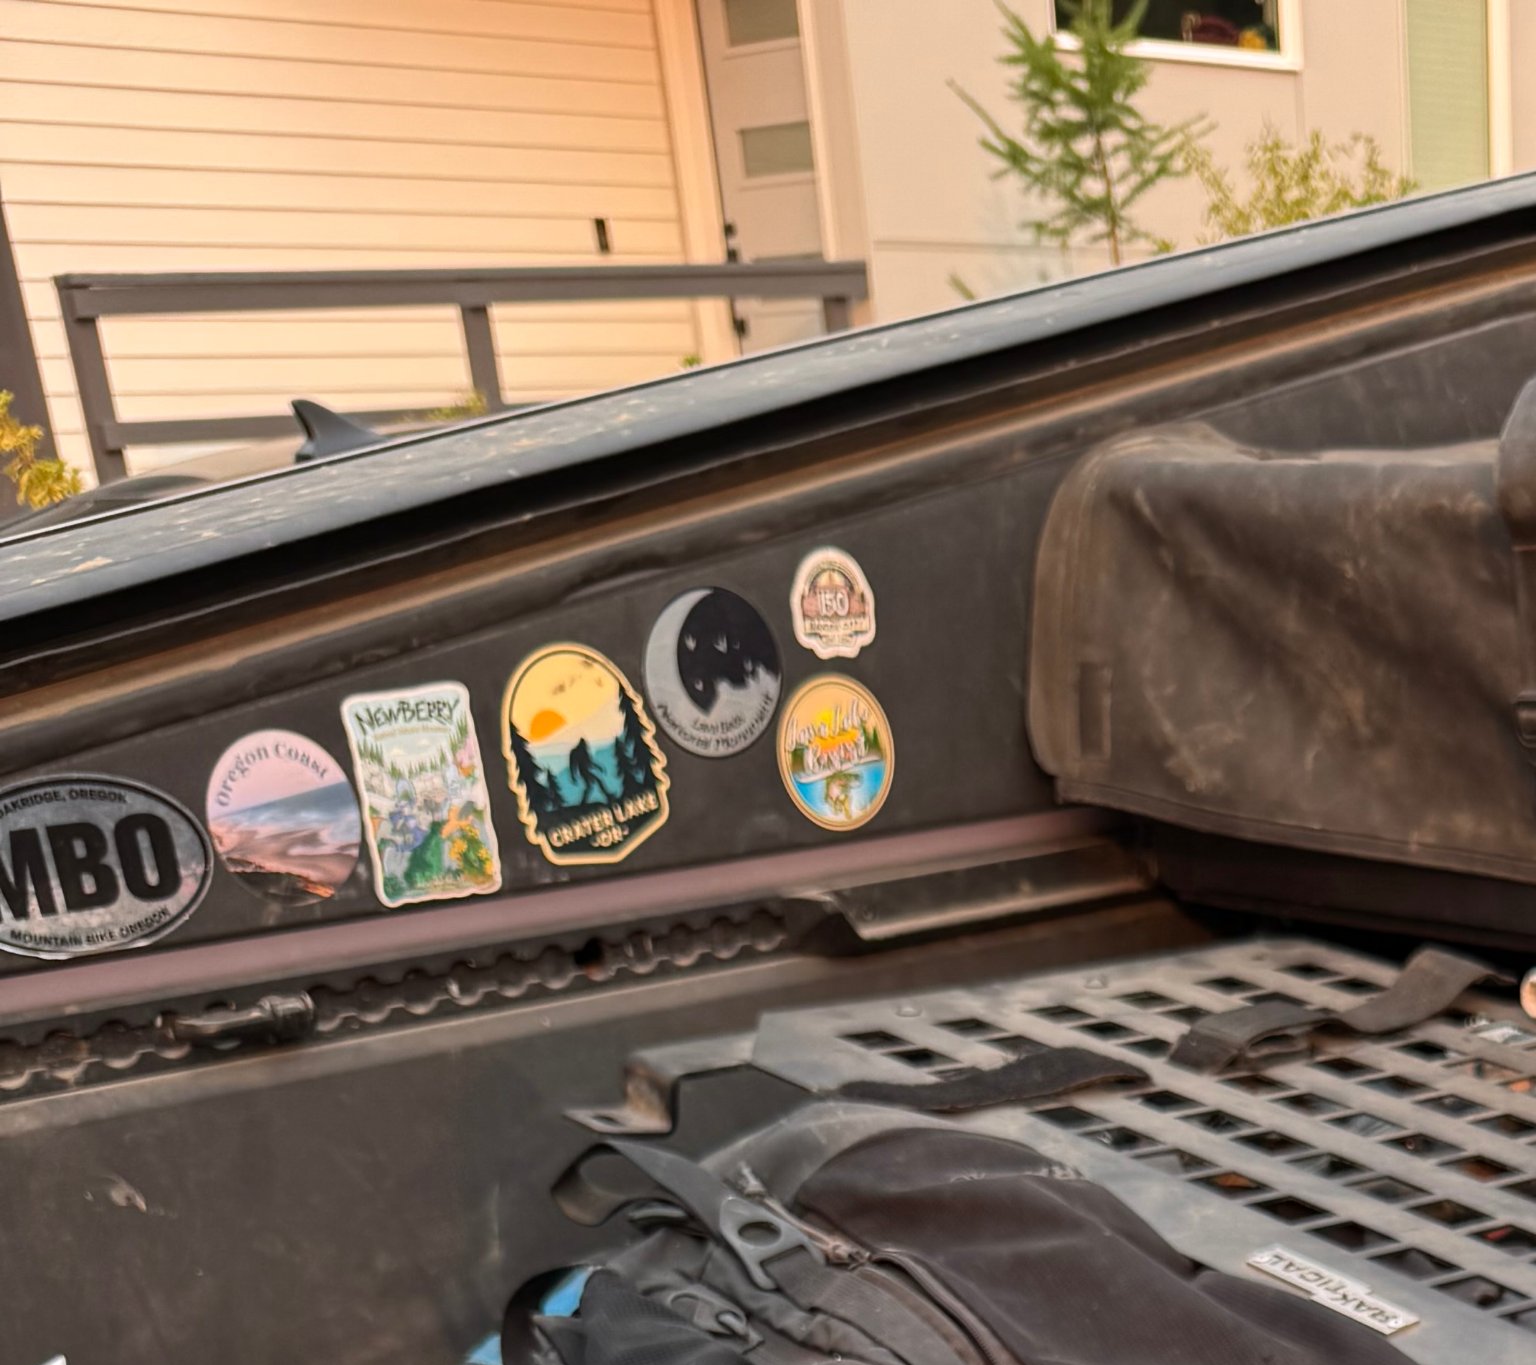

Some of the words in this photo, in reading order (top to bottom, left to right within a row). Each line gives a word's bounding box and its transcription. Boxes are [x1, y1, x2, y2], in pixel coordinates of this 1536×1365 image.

[69, 788, 128, 804] OREGON
[216, 746, 269, 807] Oregon
[274, 742, 328, 779] Coast
[551, 807, 613, 847] CRATER
[612, 792, 658, 823] LAKE
[11, 930, 82, 947] MOUNTAIN
[85, 931, 115, 945] BIKE
[119, 906, 170, 937] OREGON
